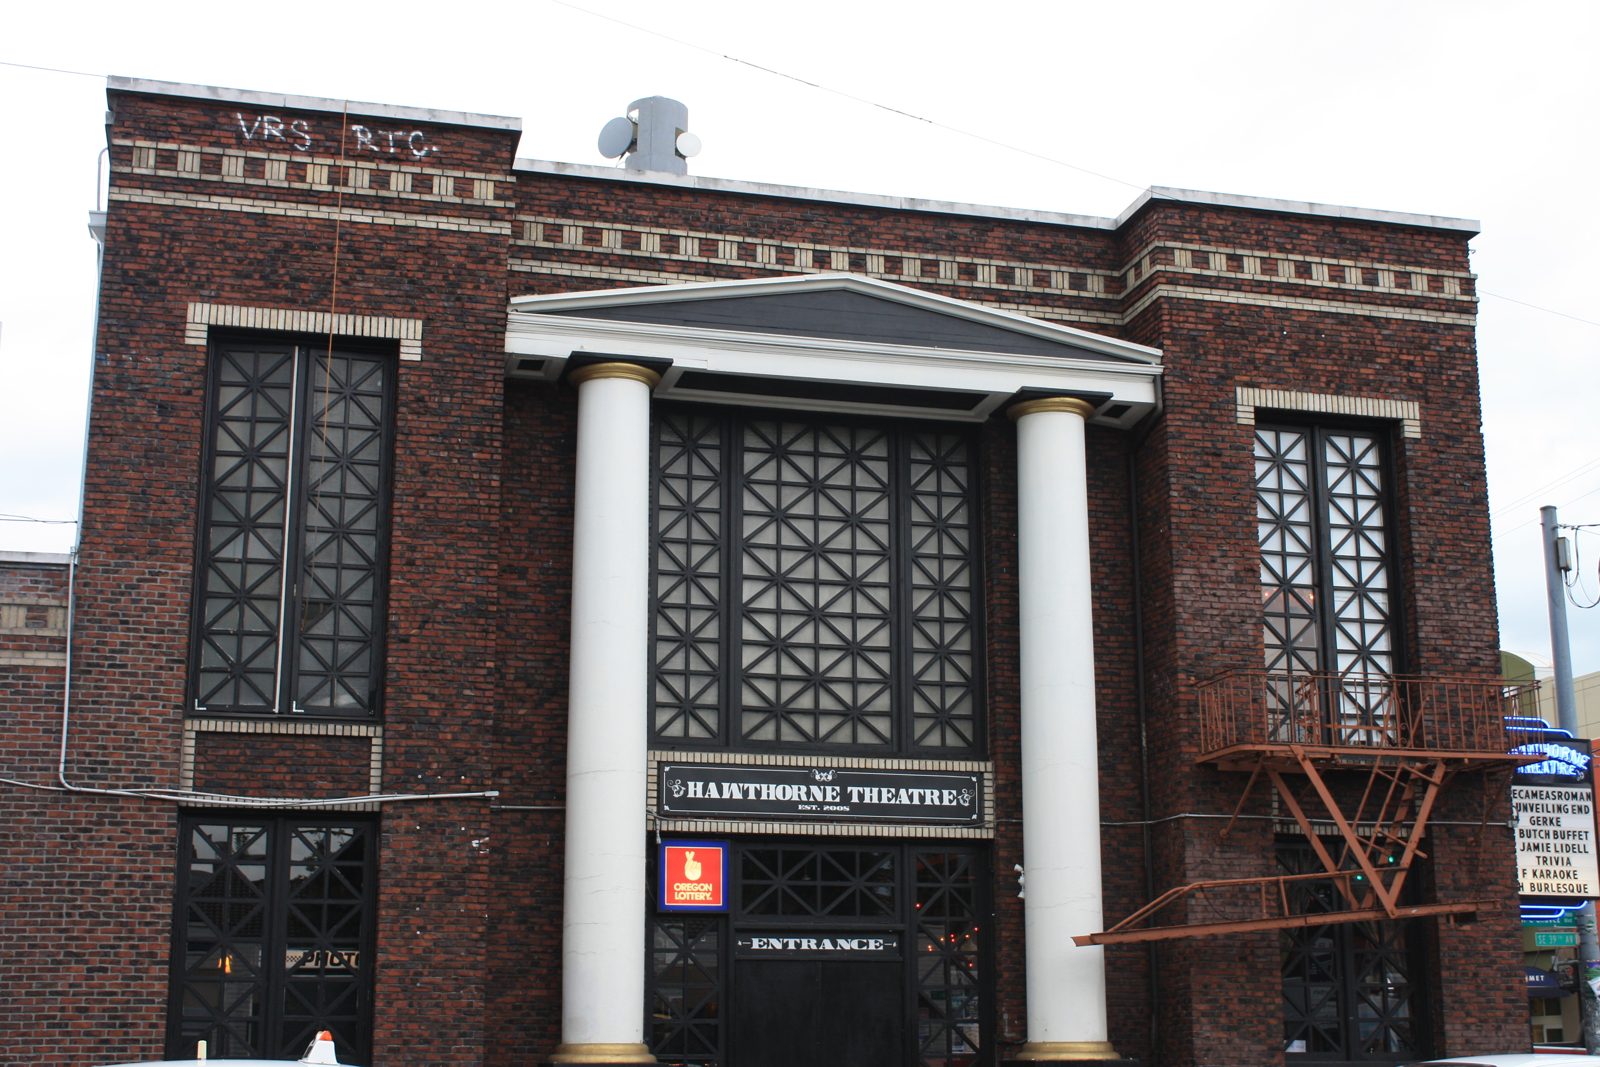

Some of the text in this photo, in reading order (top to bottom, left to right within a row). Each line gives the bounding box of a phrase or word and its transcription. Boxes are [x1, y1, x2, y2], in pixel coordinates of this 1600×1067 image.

[686, 781, 957, 806] HAWTHORNE THEATRE
[1571, 804, 1590, 815] END
[1529, 816, 1561, 827] GERKE
[1519, 829, 1589, 841] BUTCH BUFFET
[1520, 843, 1589, 854] JAMIE LIDELL
[1536, 856, 1572, 866] TRIVIA
[1532, 869, 1578, 880] KARAOKE
[673, 883, 713, 892] OREGON
[1530, 882, 1589, 894] BURLESQUE
[751, 938, 884, 950] ENTRANCE
